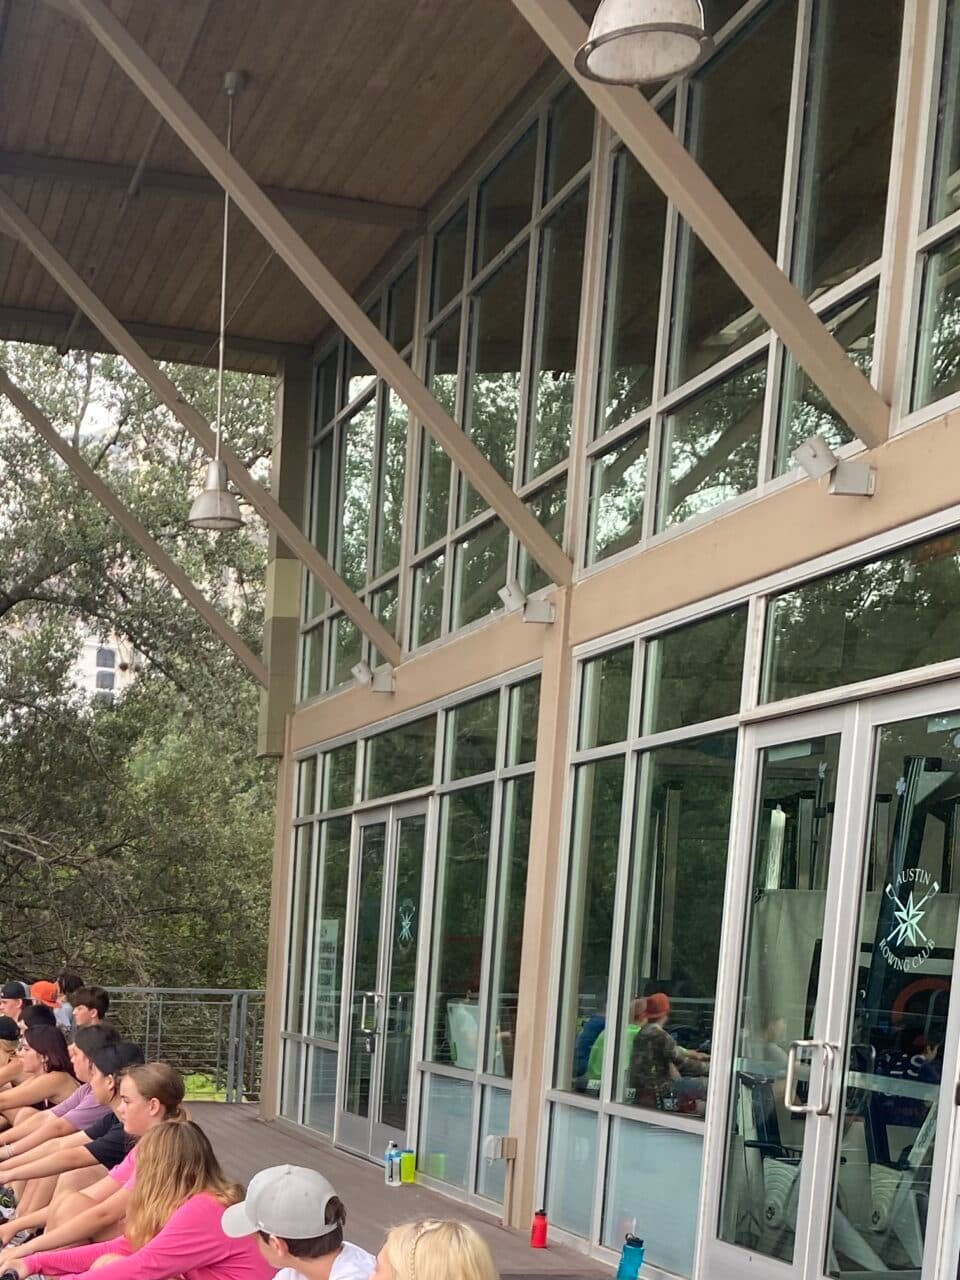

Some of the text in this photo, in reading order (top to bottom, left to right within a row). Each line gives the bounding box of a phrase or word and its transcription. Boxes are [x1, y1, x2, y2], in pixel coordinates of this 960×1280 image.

[897, 868, 931, 885] AUSTIN
[879, 938, 936, 971] ROWING CLUB
